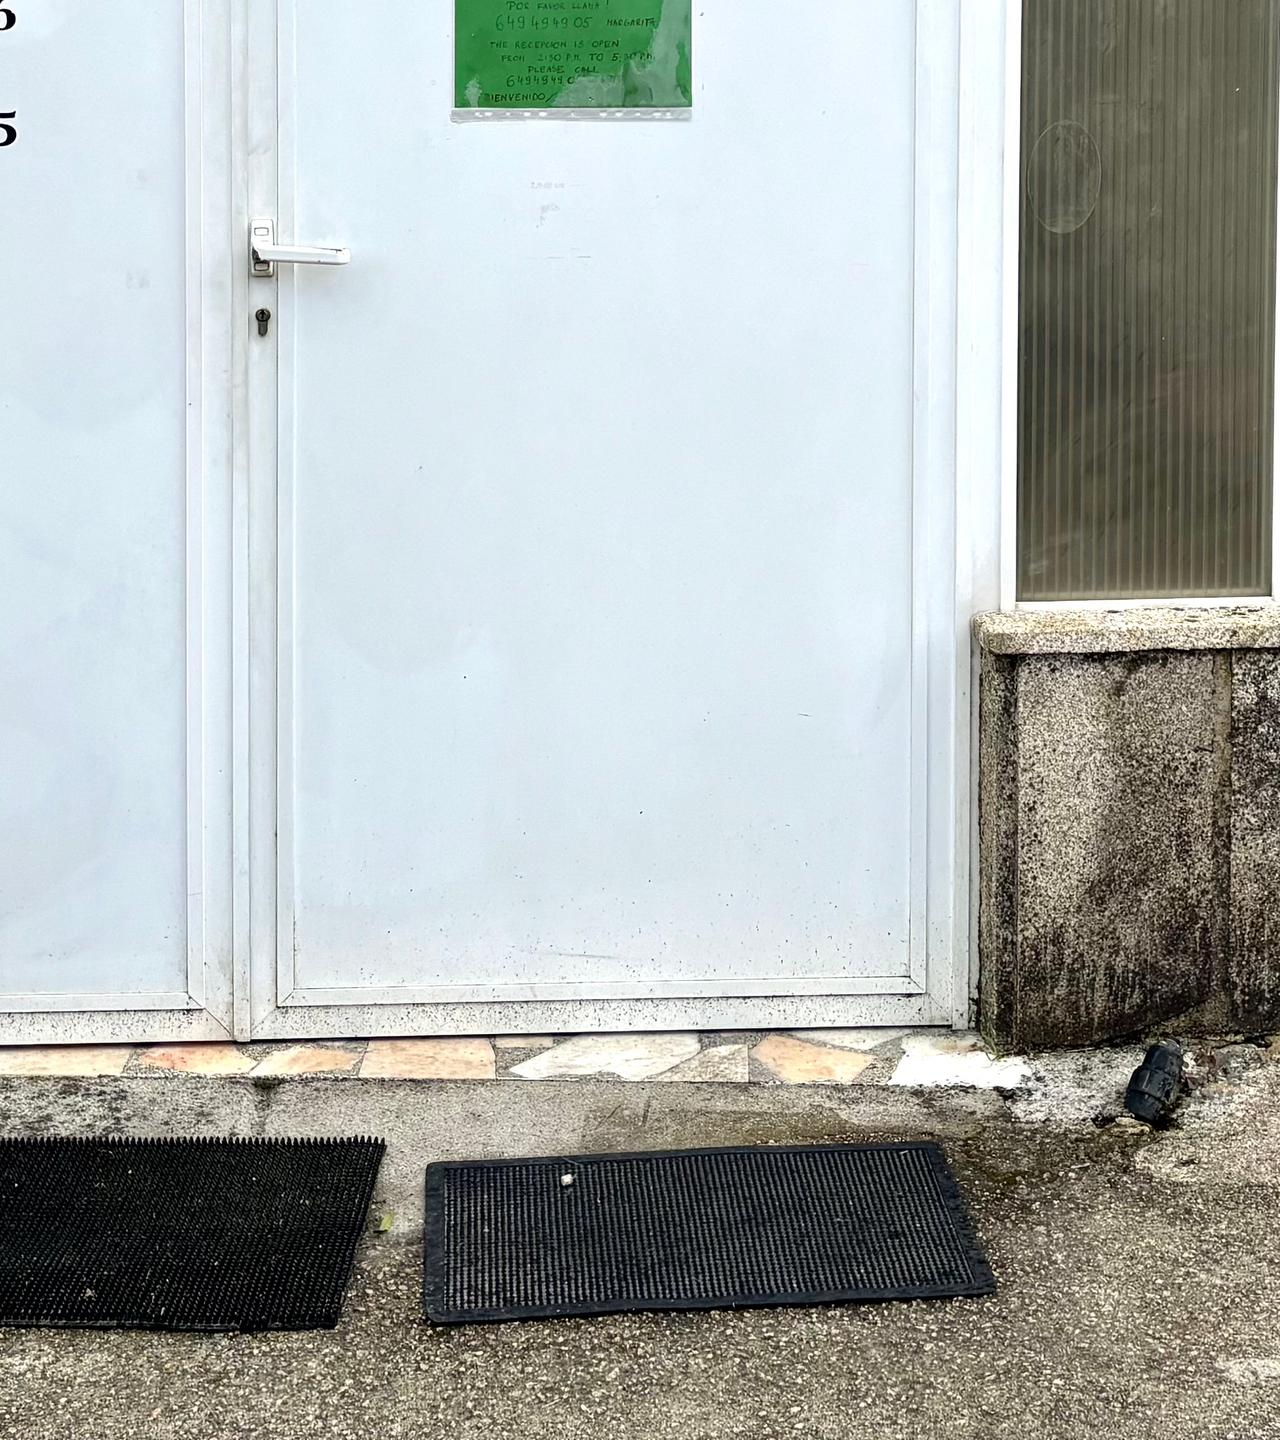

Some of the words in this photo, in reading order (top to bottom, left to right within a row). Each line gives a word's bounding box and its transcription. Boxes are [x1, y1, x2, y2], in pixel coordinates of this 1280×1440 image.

[592, 39, 619, 48] OPEN
[590, 53, 604, 62] TO
[528, 65, 565, 74] PLEASE
